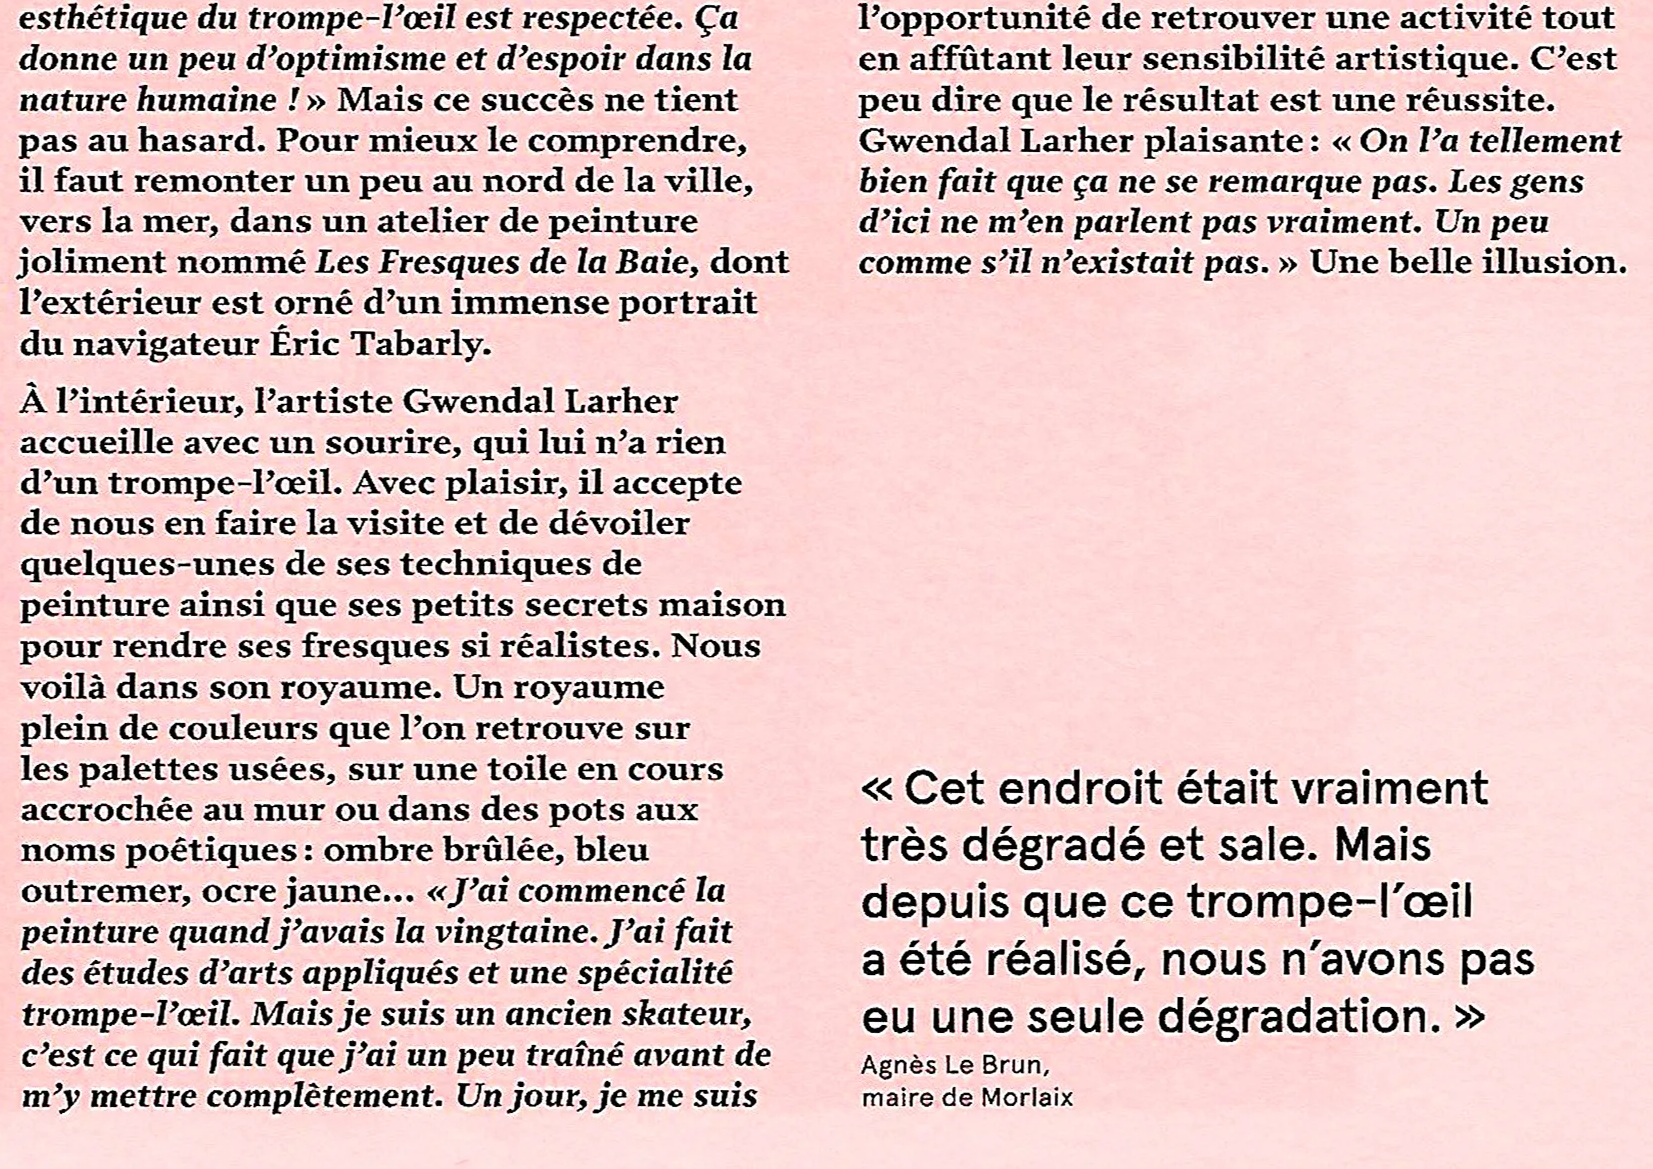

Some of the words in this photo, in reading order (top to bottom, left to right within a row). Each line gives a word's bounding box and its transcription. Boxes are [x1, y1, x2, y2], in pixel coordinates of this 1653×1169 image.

[16, 247, 167, 280] joliment
[178, 249, 306, 274] nommé
[315, 249, 369, 274] Les
[378, 249, 519, 280] Fresques
[530, 247, 566, 274] de
[578, 247, 606, 273] la
[615, 247, 698, 278] Baie,
[711, 247, 790, 273] dont
[906, 769, 984, 805] Cet
[1000, 769, 1162, 805] endroit
[1178, 769, 1278, 804] était
[1291, 769, 1488, 804] vraiment
[861, 826, 948, 861] très
[963, 826, 1145, 870] dégradé
[1161, 826, 1204, 861] et
[1219, 826, 1317, 861] sale.
[1337, 826, 1430, 861] Mais
[862, 882, 1009, 927] depuis
[1024, 892, 1106, 927] que
[1122, 892, 1173, 918] ce
[1187, 882, 1471, 927] trompe-l'œil
[863, 950, 884, 975] a
[900, 940, 971, 976] été
[988, 939, 1145, 981] réalisé,
[1163, 949, 1266, 975] nous
[1283, 940, 1444, 975] n'avons
[1462, 949, 1534, 985] pas
[863, 1007, 914, 1033] eu
[933, 1007, 1013, 1033] une
[1028, 997, 1144, 1033] seule
[1159, 997, 1439, 1042] dégradation.
[861, 1054, 936, 1080] Agnès
[946, 1055, 973, 1074] Le
[983, 1055, 1049, 1076] Brun,
[863, 1087, 933, 1107] maire
[942, 1087, 972, 1106] de
[982, 1087, 1073, 1107] Morlaix
